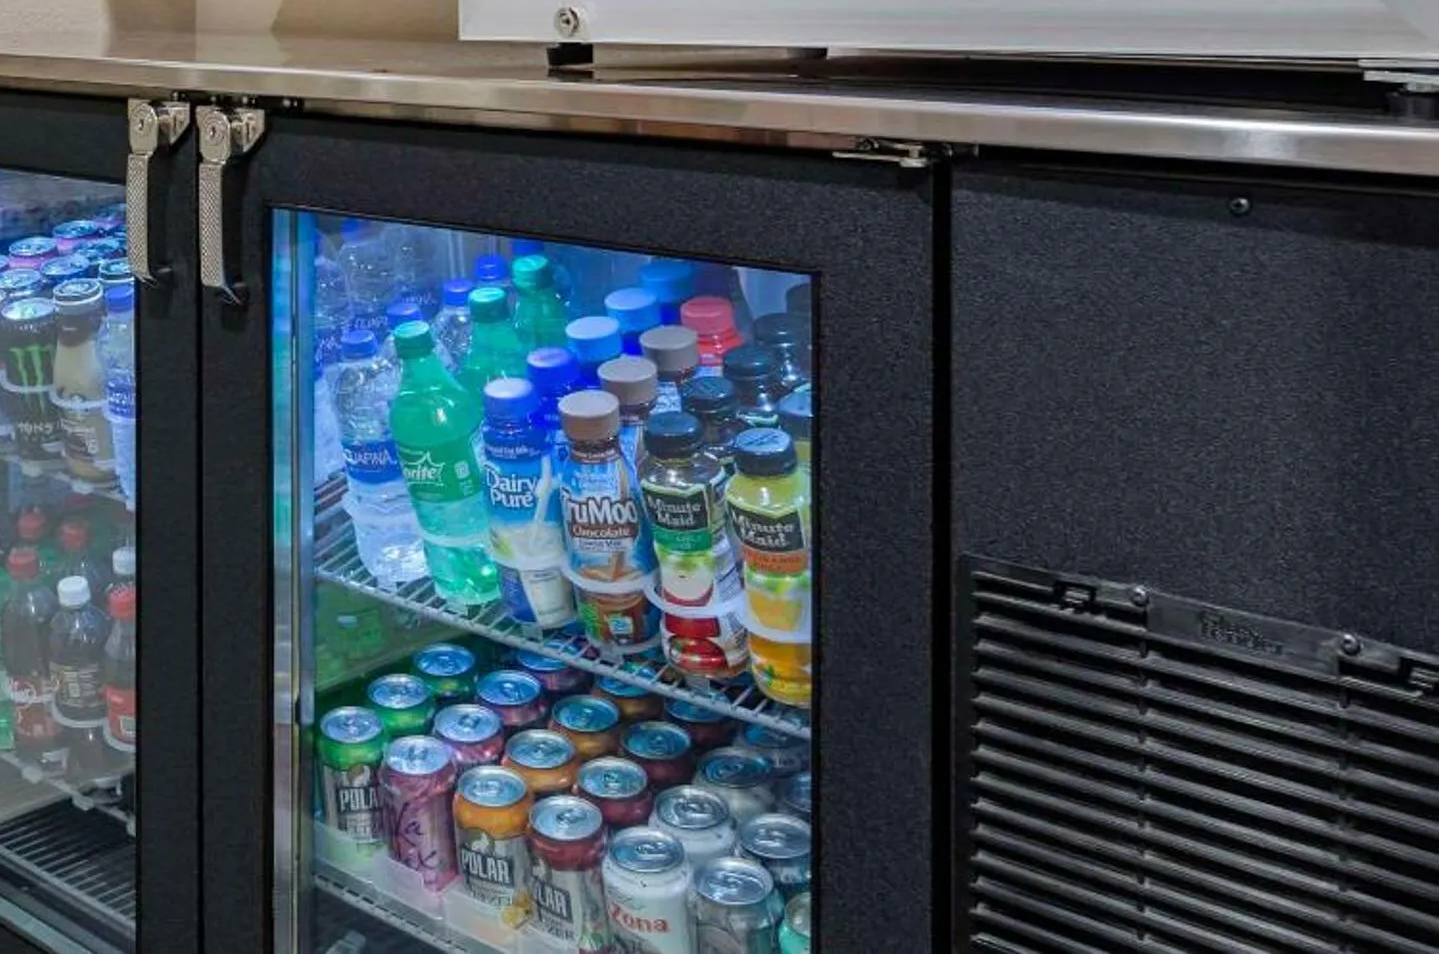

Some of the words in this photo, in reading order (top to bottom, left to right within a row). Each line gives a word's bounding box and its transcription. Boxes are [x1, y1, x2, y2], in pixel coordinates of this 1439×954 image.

[484, 463, 539, 495] Dairy
[490, 487, 534, 508] Pure
[647, 495, 701, 513] Minute
[656, 510, 694, 526] Maid
[732, 509, 795, 533] Minute
[741, 526, 788, 546] Maid
[339, 787, 379, 812] POLA
[461, 848, 510, 884] POLAR
